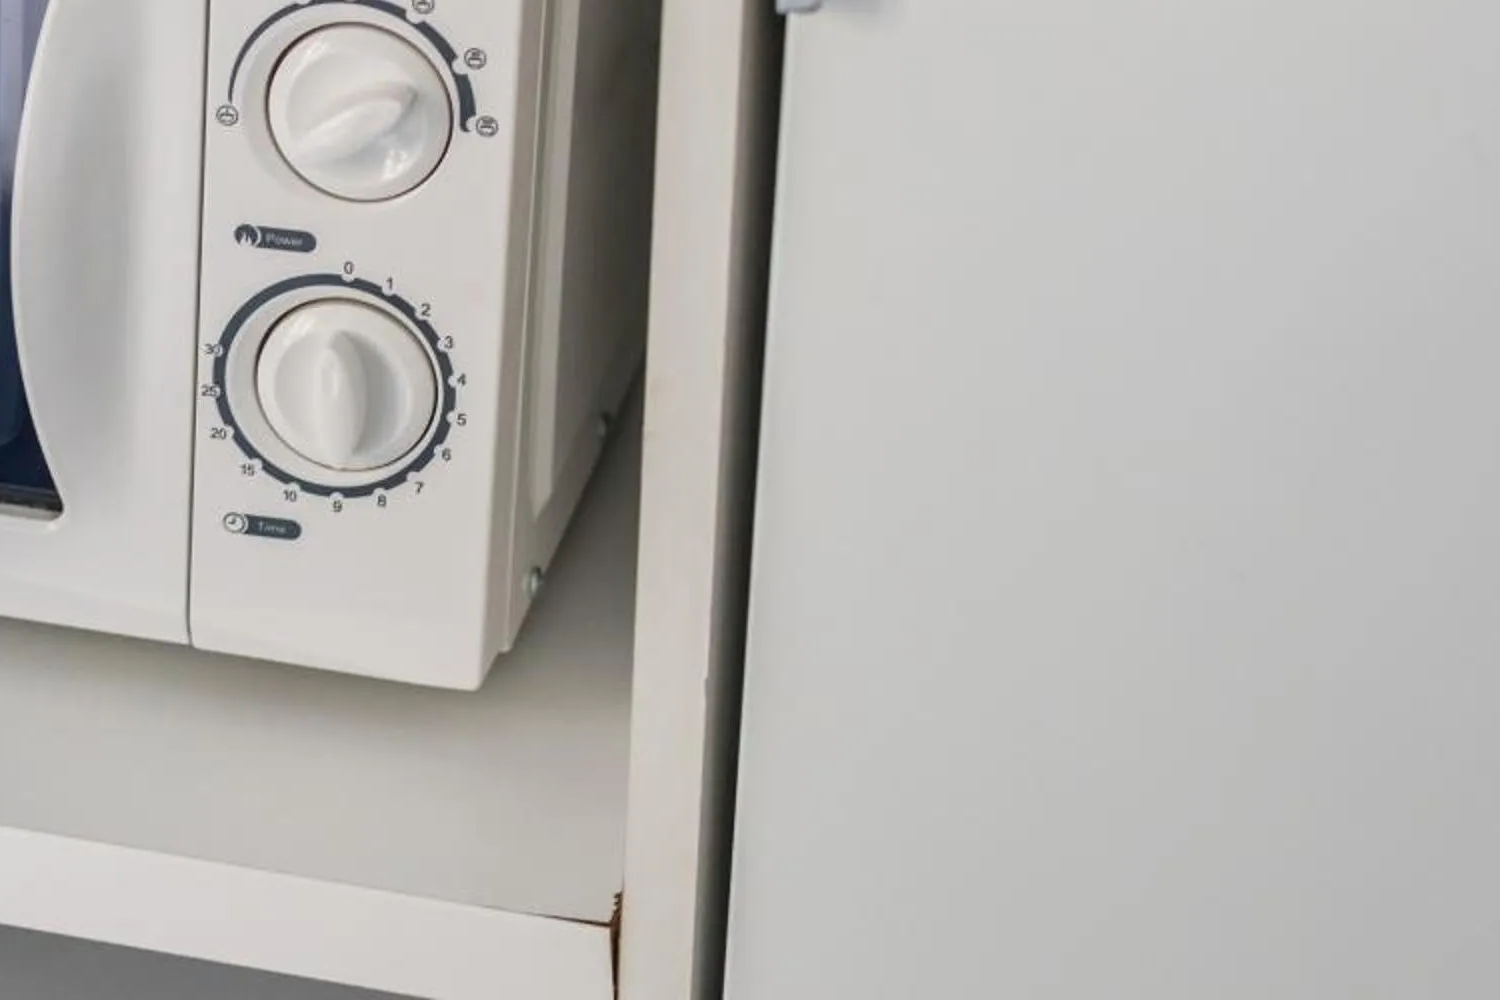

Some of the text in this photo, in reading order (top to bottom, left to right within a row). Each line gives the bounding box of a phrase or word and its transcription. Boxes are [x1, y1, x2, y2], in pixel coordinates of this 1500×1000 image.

[343, 261, 354, 275] 0
[385, 277, 394, 290] 1
[420, 303, 431, 317] 2
[443, 335, 454, 349] 3
[457, 373, 467, 386] 4
[201, 384, 220, 397] 25
[456, 413, 467, 427] 5
[210, 427, 227, 440] 20
[441, 448, 452, 461] 6
[241, 463, 255, 476] 15
[414, 481, 424, 493] 7
[283, 489, 297, 501] 10
[332, 499, 343, 512] 9
